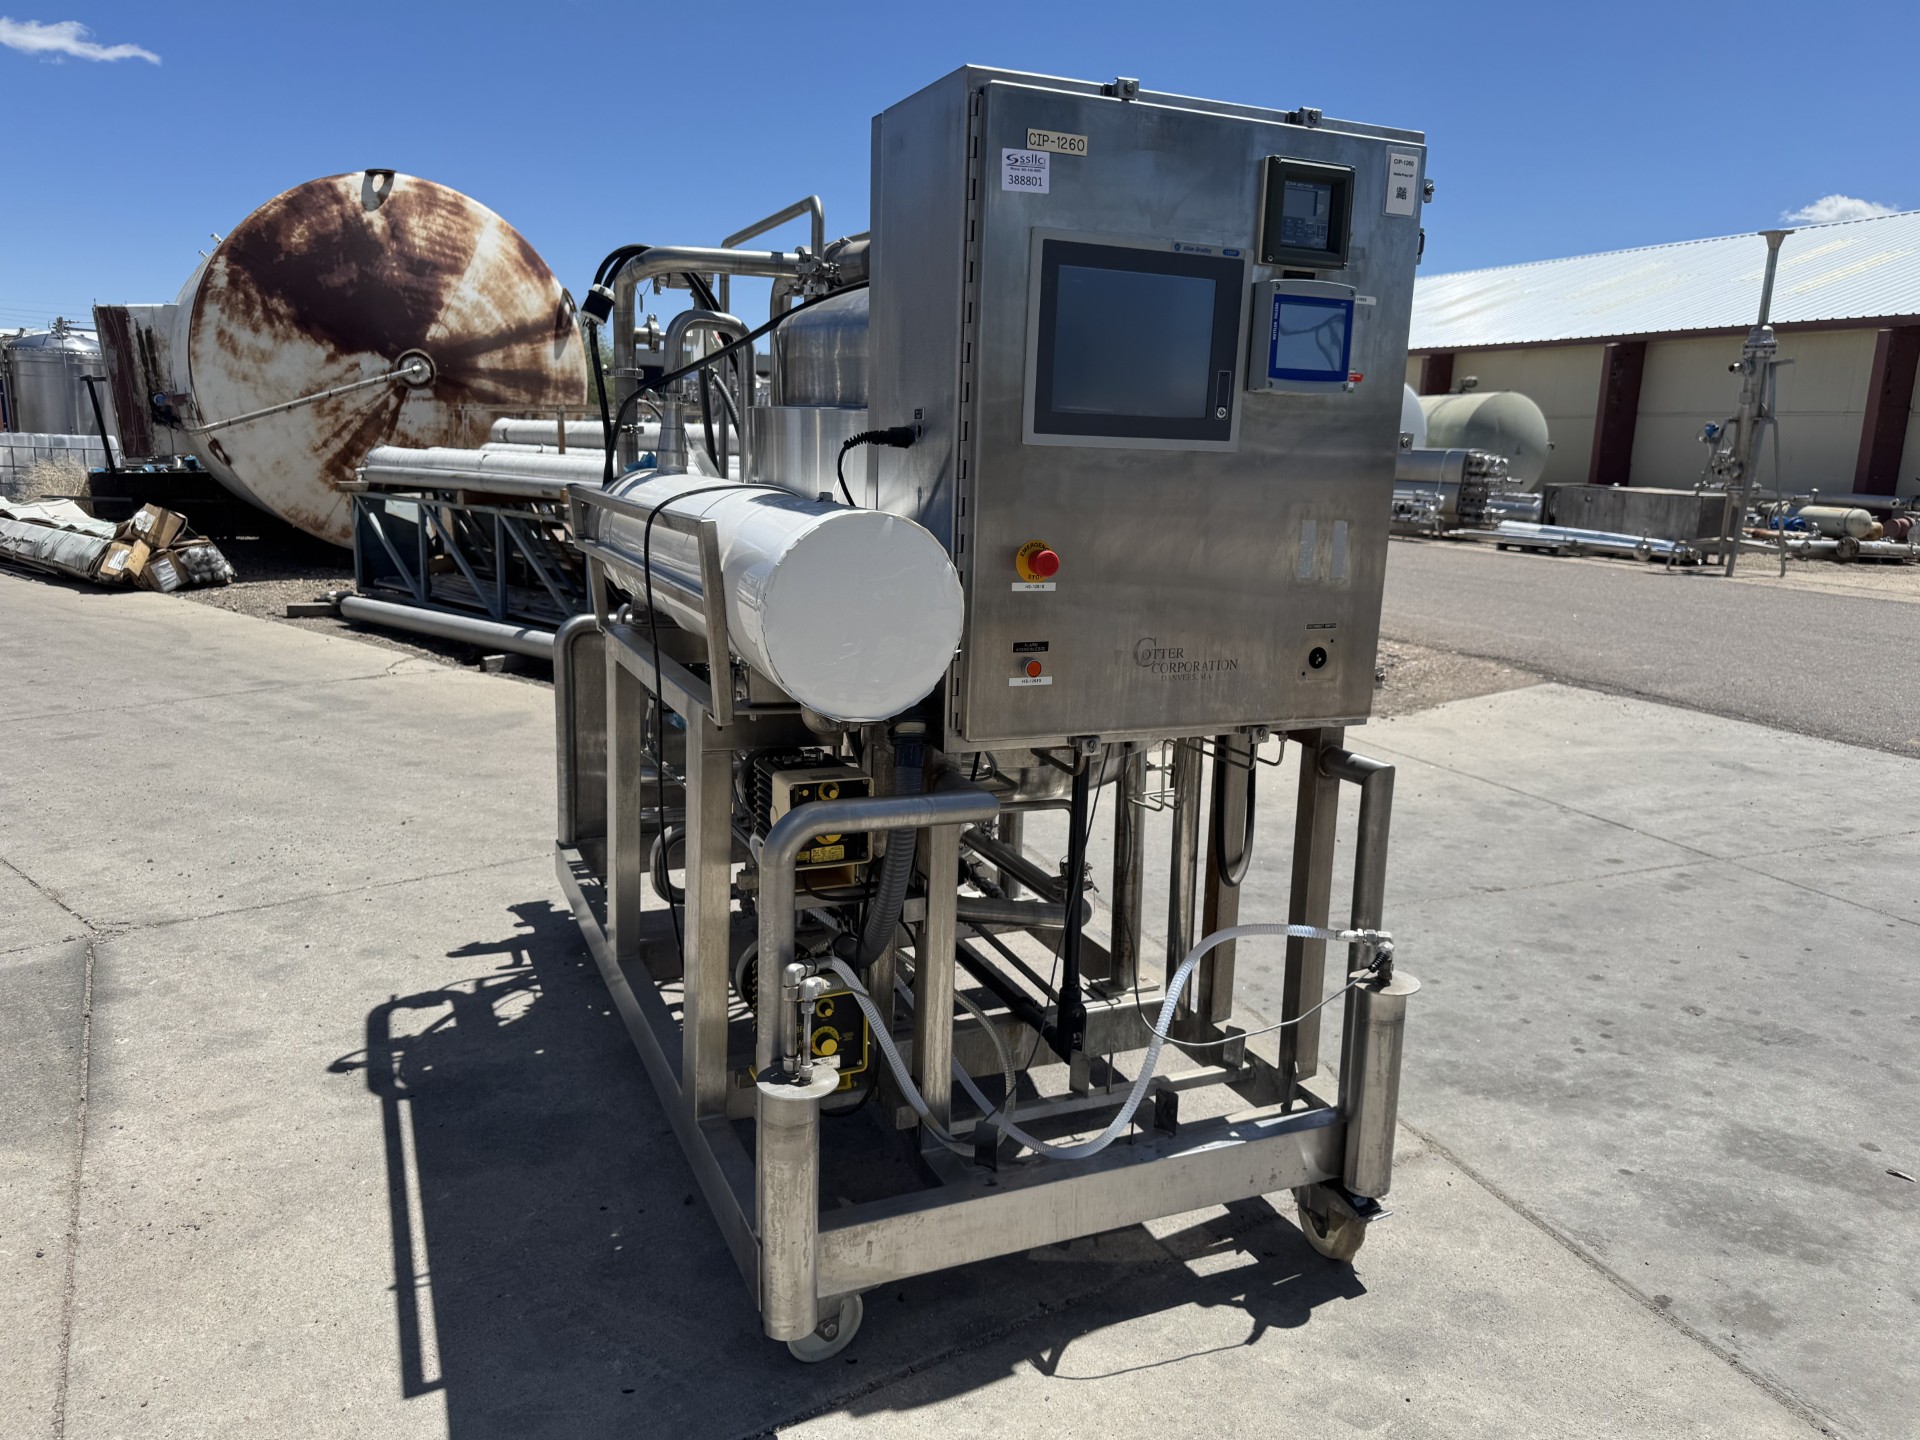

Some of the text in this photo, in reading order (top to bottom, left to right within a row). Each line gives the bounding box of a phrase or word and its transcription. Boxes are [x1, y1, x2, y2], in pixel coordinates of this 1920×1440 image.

[1029, 132, 1085, 152] CIP-1260
[1019, 153, 1044, 165] ssllc
[1008, 174, 1043, 187] 388801
[1151, 659, 1238, 674] CORPORATION
